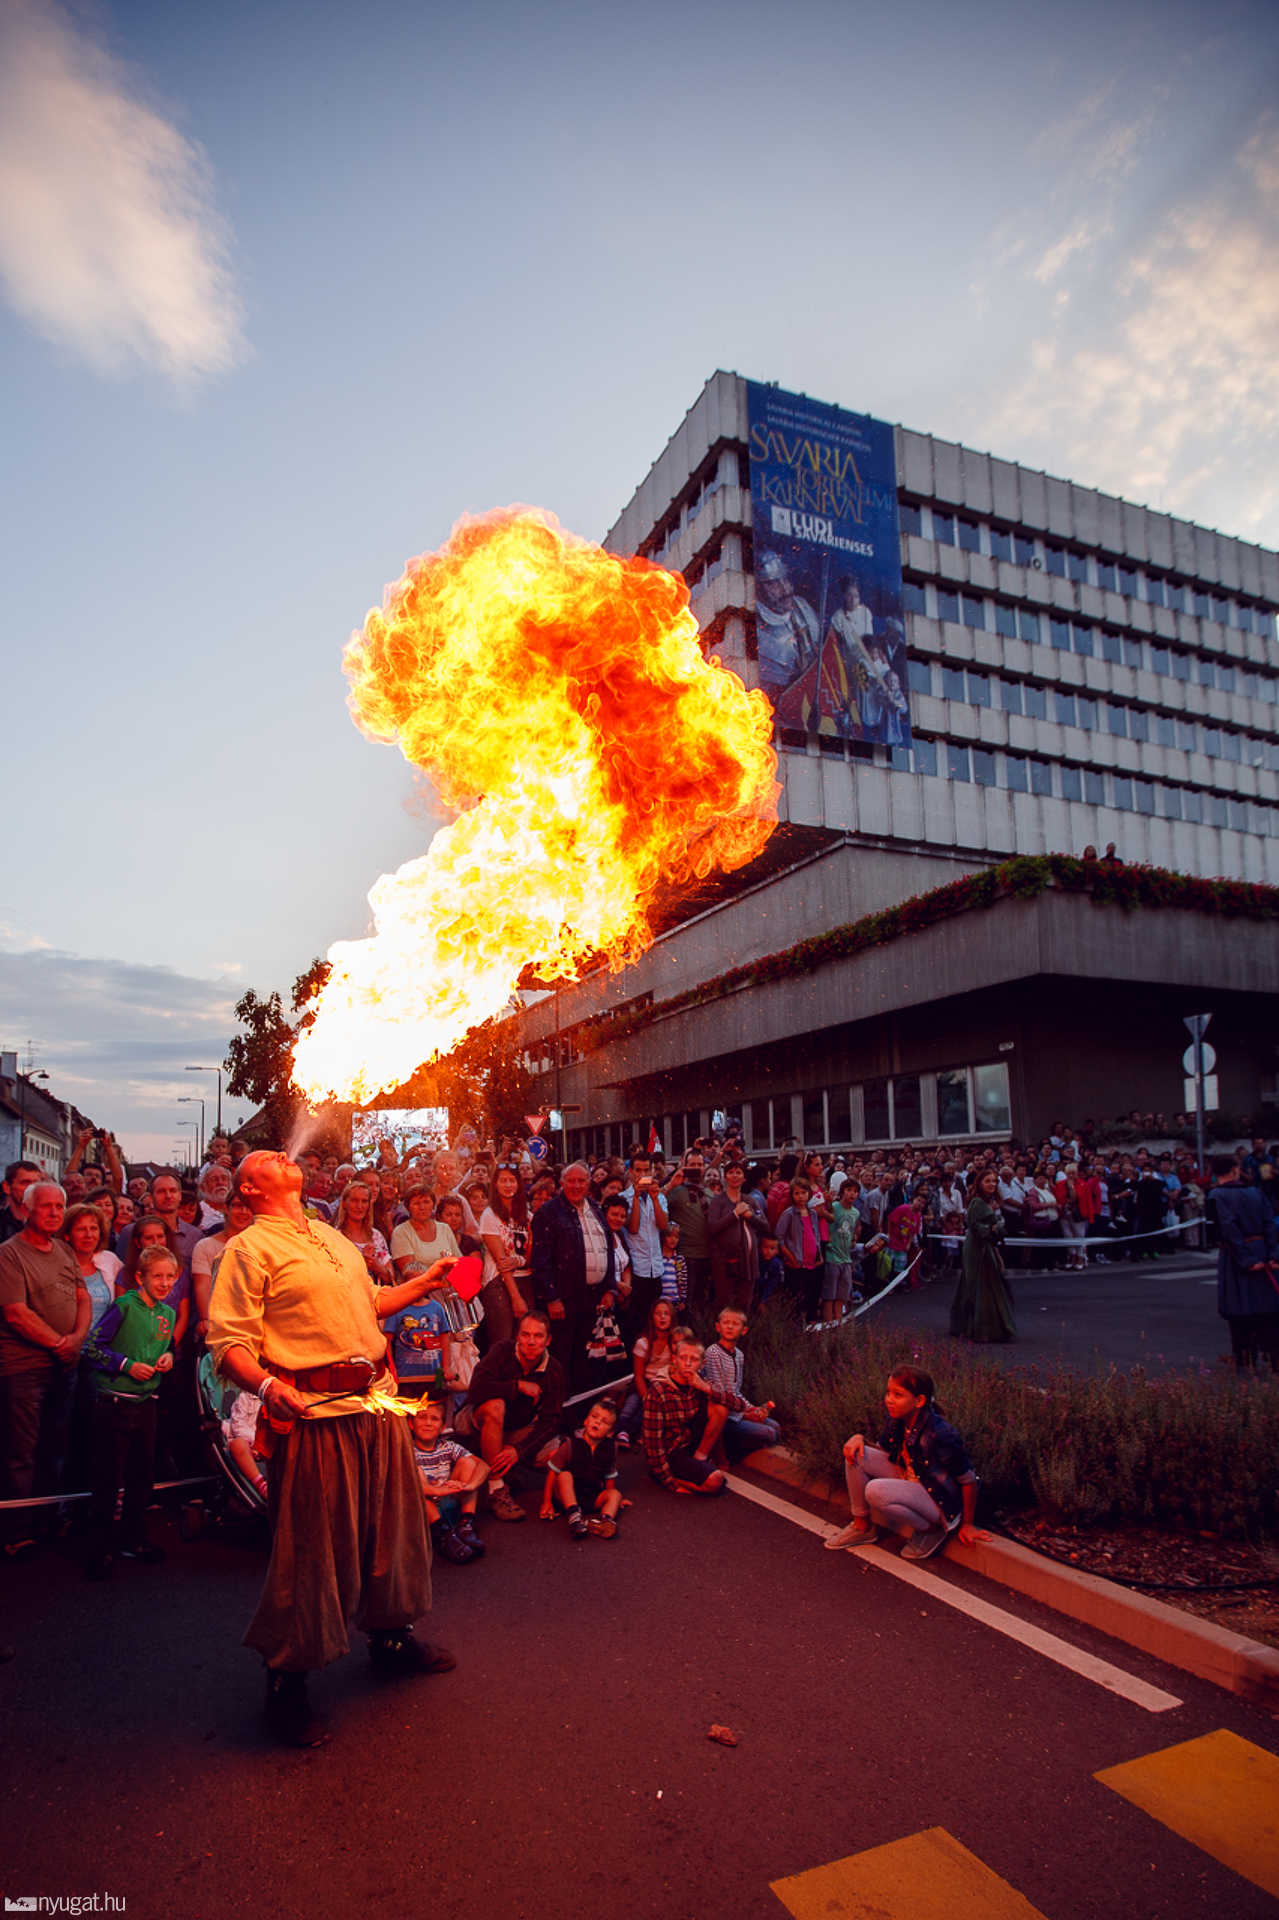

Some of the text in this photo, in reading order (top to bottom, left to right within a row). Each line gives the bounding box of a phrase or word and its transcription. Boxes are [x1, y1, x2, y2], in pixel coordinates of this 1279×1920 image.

[749, 423, 862, 485] SAVARIA
[792, 510, 834, 538] LUDI
[793, 526, 875, 557] SAVARIENSES
